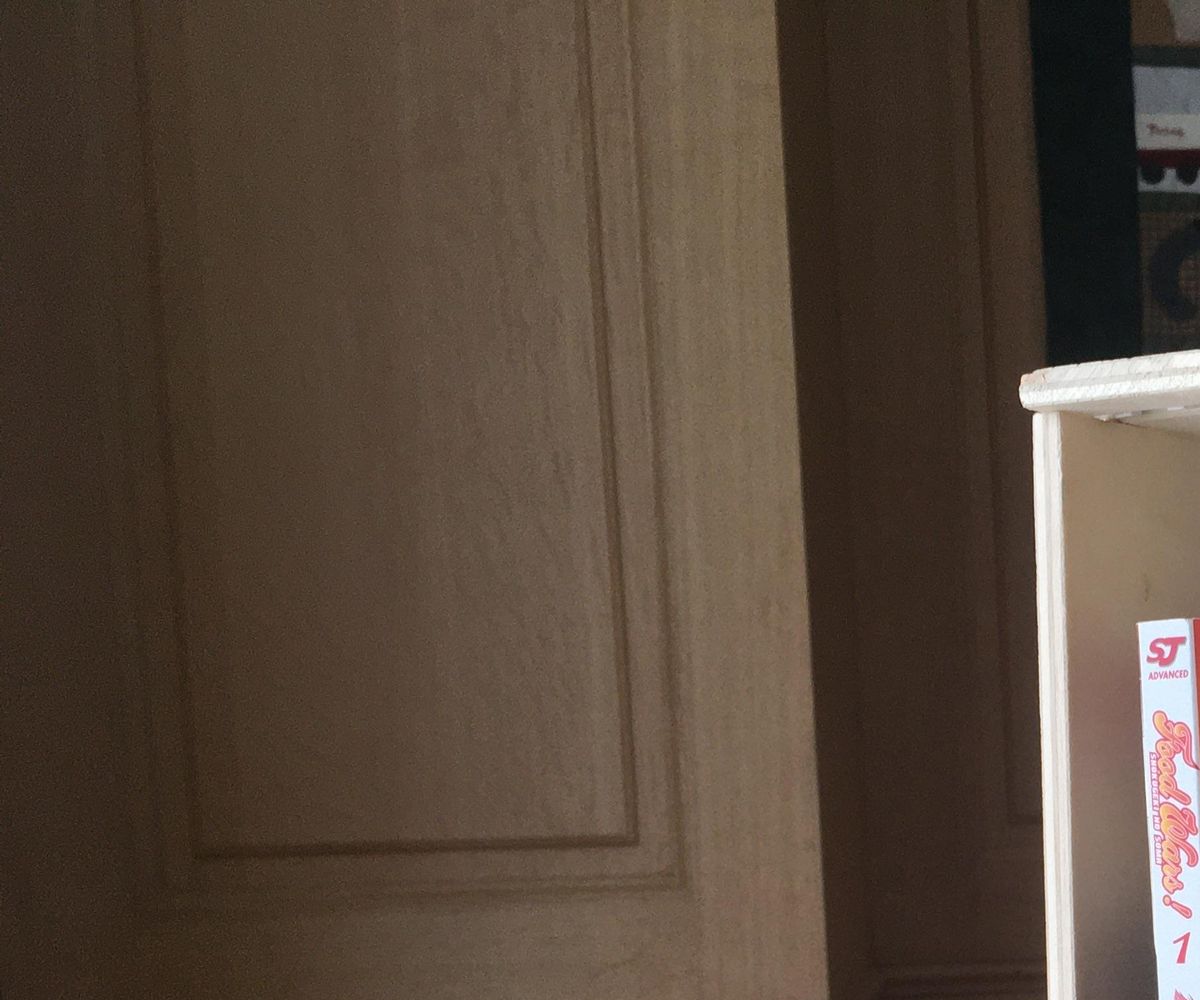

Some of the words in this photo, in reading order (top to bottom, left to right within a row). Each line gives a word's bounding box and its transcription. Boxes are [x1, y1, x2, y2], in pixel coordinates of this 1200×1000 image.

[1148, 669, 1189, 681] ADVANCED
[1152, 710, 1200, 806] Food
[1159, 802, 1199, 919] Wars!
[1172, 931, 1191, 964] 1
